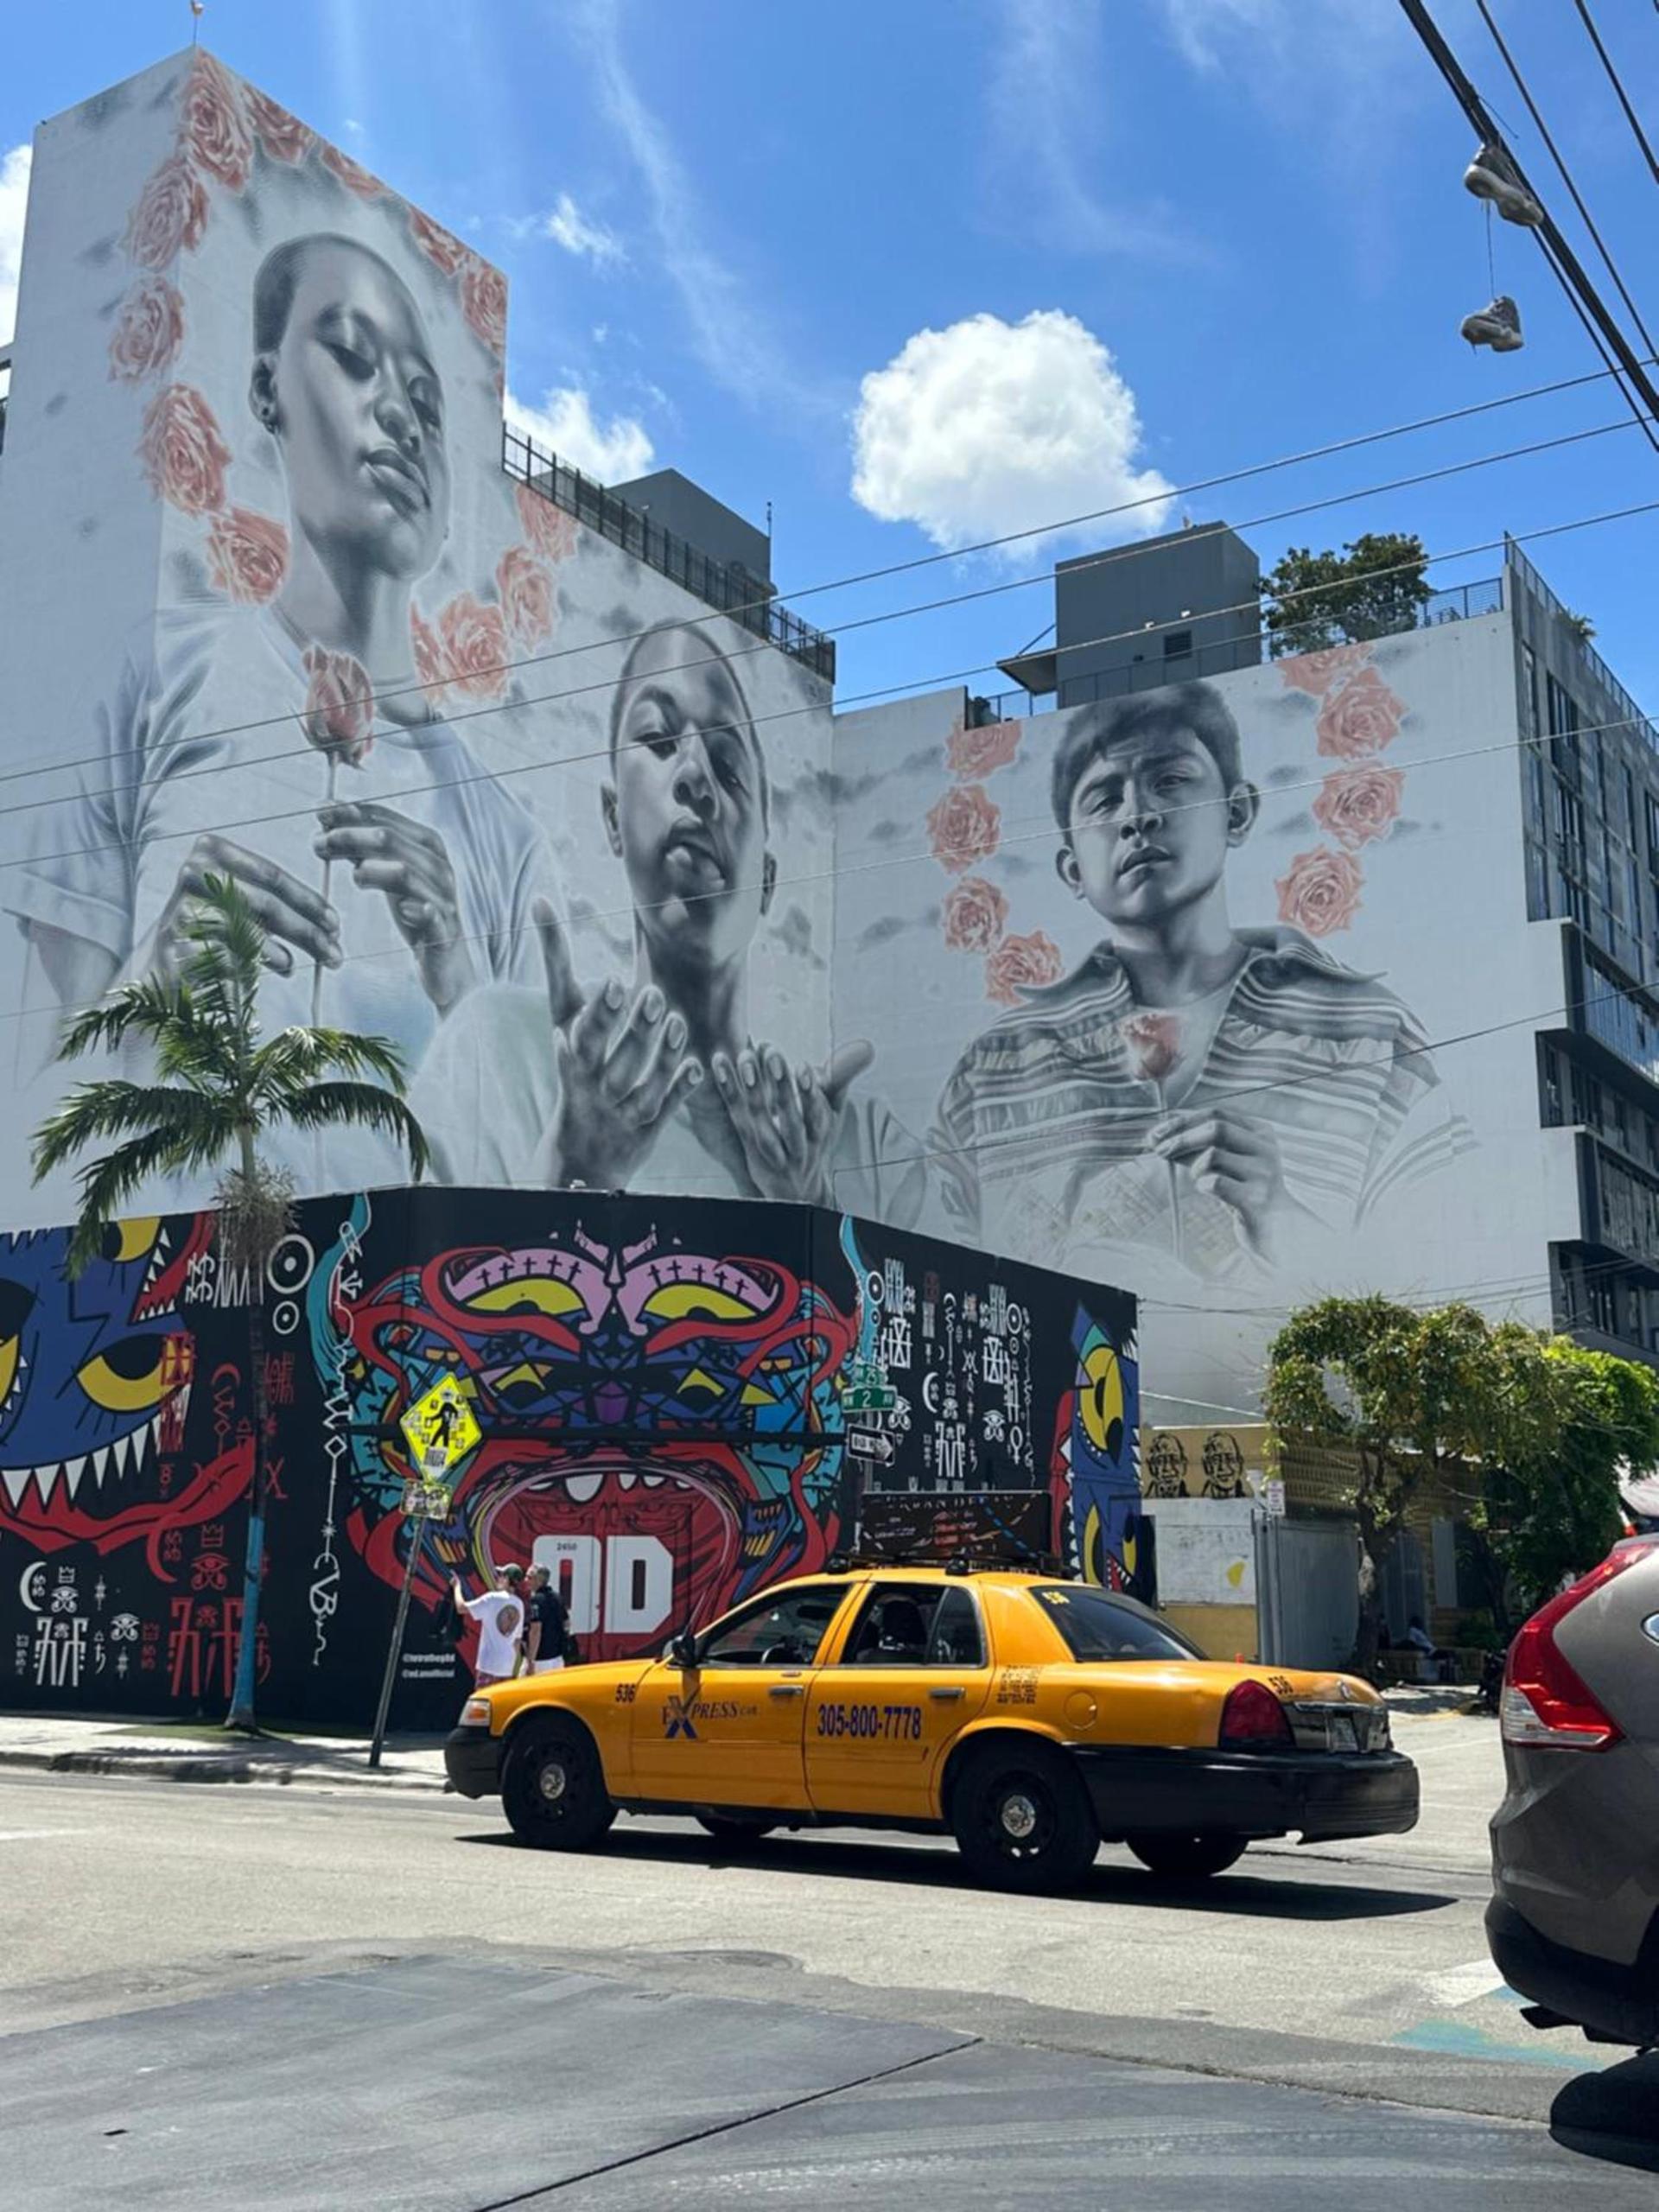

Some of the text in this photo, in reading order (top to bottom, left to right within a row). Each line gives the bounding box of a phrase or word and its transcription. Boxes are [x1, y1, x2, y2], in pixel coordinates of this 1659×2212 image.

[862, 1389, 871, 1408] 2
[615, 1684, 635, 1702] 536
[817, 1704, 922, 1739] 305-800-7778
